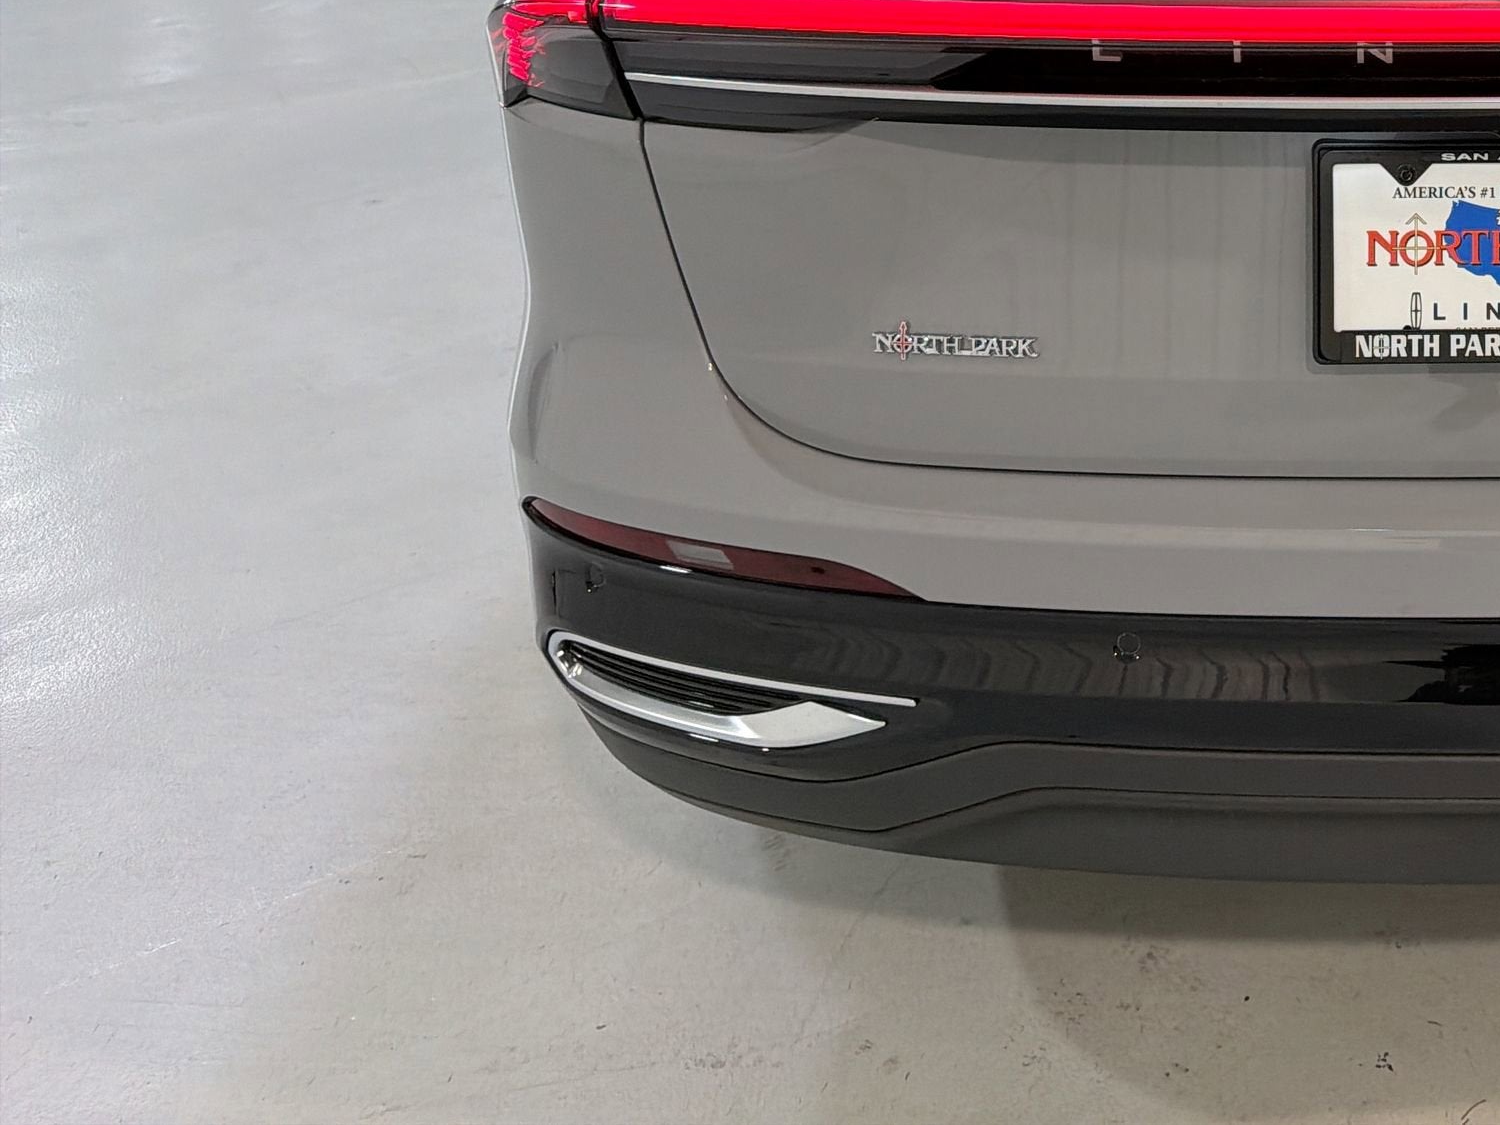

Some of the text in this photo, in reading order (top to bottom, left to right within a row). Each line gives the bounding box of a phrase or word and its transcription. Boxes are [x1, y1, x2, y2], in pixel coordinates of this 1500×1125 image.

[1441, 152, 1489, 161] SAN
[1392, 186, 1477, 199] AMERICA'S
[1480, 186, 1496, 199] #1
[872, 332, 1039, 358] NORTH PARK
[1355, 334, 1440, 358] NORTH
